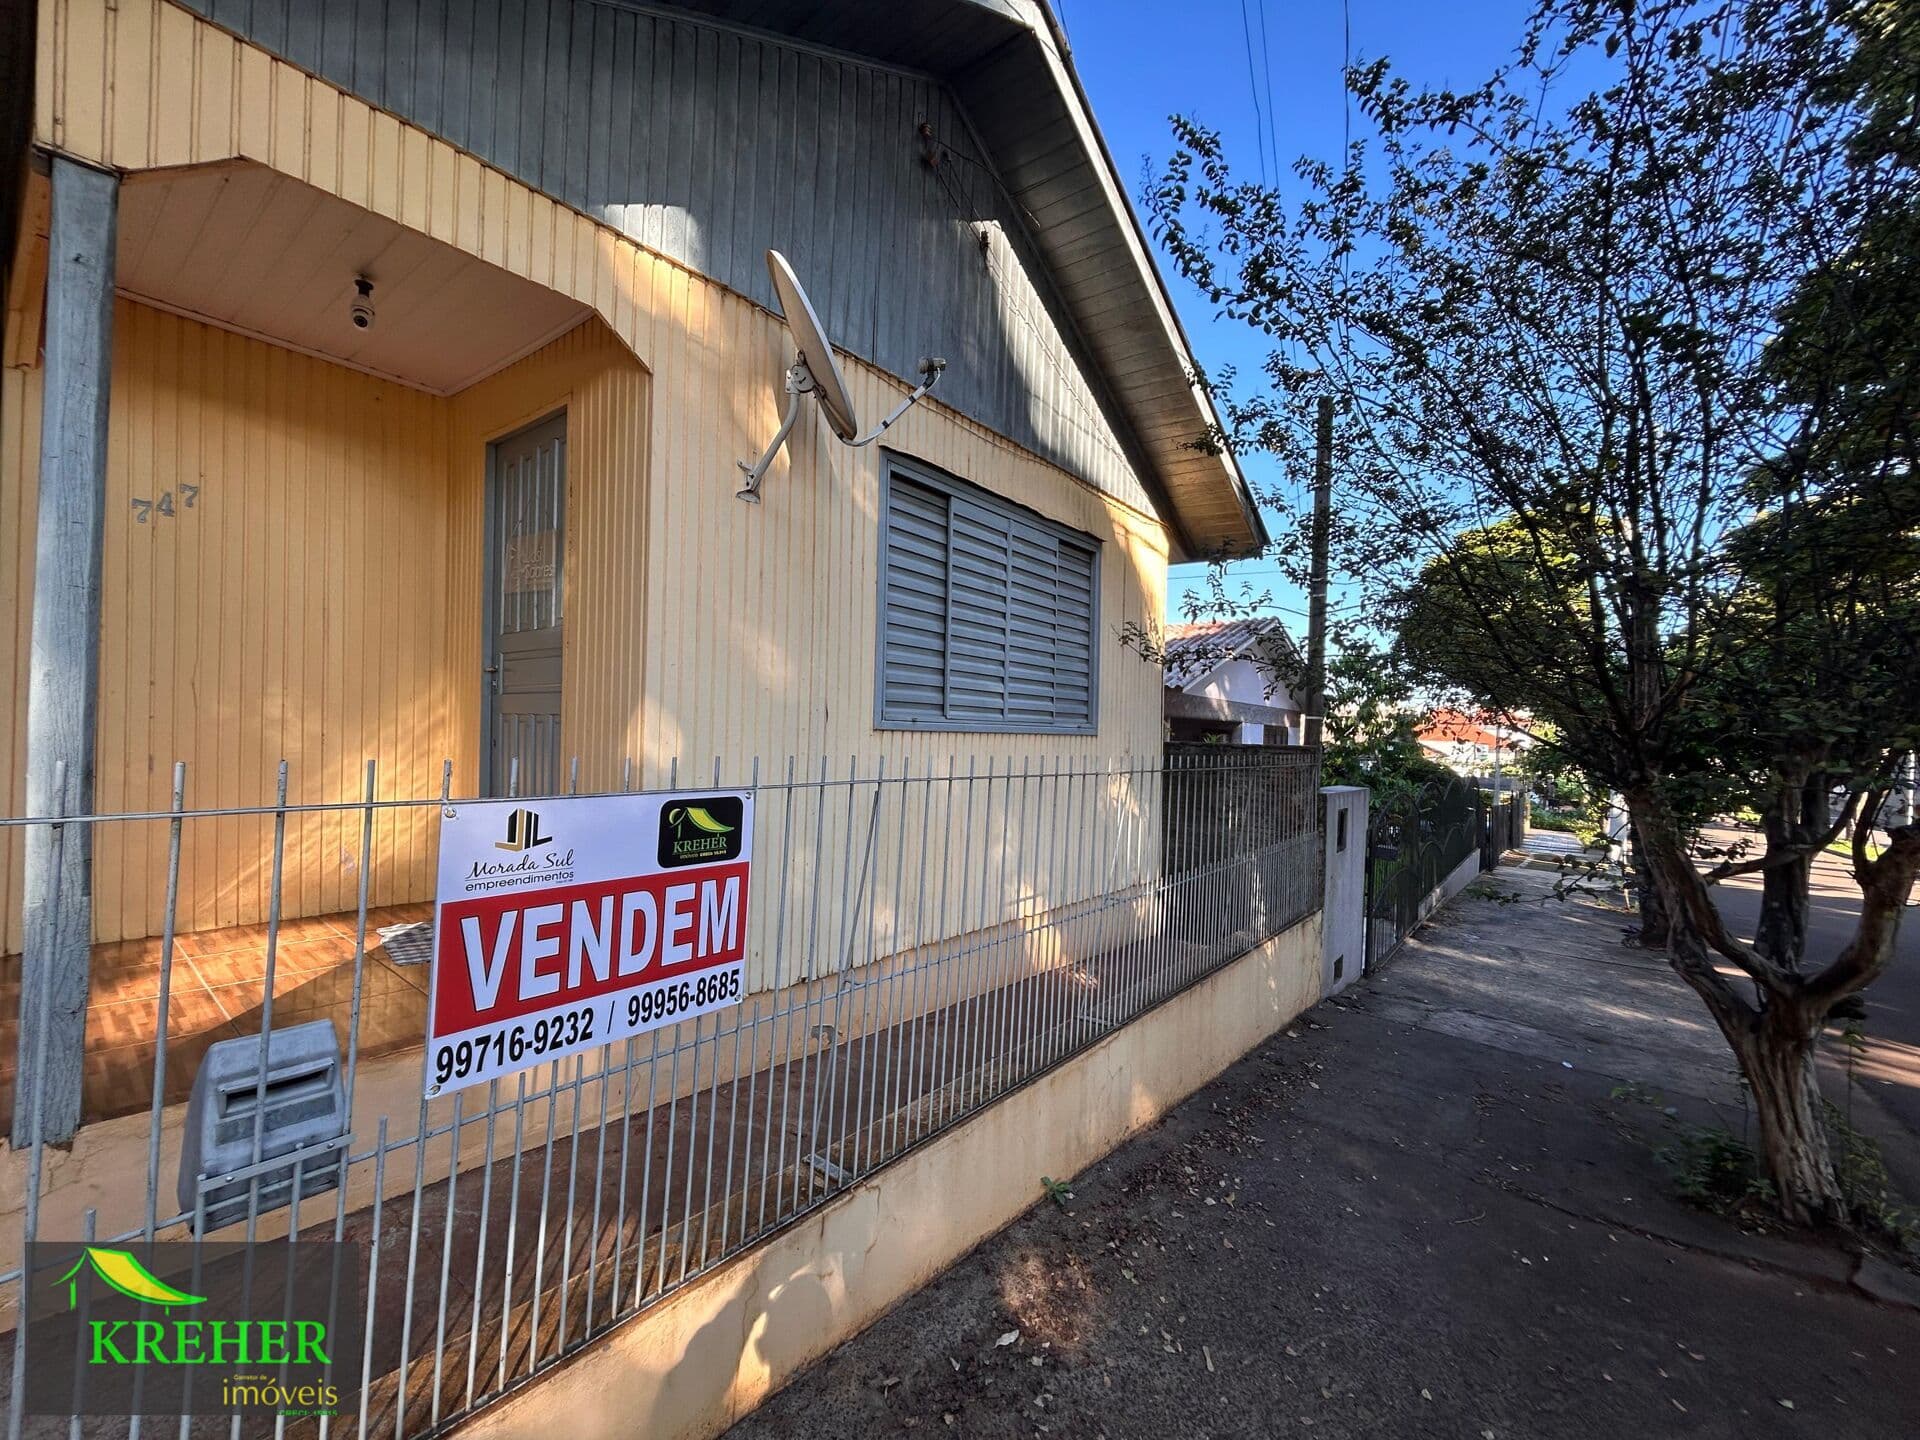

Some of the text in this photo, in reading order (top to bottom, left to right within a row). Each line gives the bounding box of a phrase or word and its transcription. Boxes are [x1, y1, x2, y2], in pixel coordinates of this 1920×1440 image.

[131, 483, 198, 523] 747
[672, 836, 728, 854] KREHER
[465, 848, 574, 879] Morada Sul
[465, 871, 574, 892] empreendimentos
[460, 875, 740, 1012] VENDEM
[436, 1007, 594, 1084] 99716-9232
[627, 968, 740, 1027] 99956-8685
